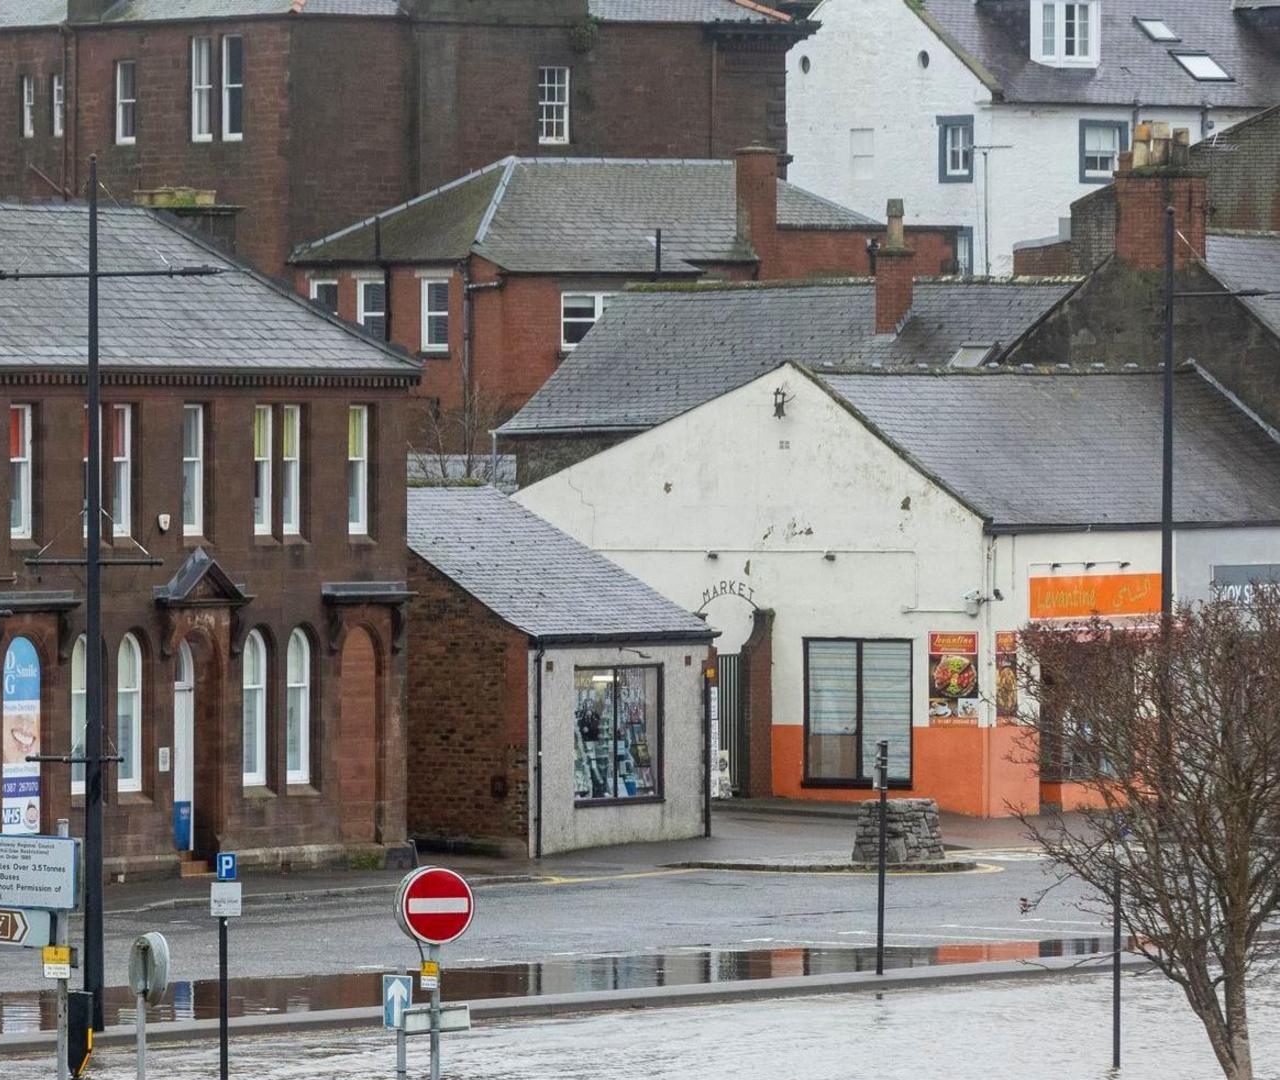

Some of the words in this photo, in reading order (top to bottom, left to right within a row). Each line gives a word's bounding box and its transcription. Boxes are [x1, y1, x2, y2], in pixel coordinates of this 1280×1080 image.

[702, 580, 755, 603] MARKET
[1037, 583, 1096, 609] Levantine
[16, 664, 37, 678] Smile
[2, 808, 20, 824] NHS
[13, 863, 29, 871] Over
[221, 856, 233, 877] P
[0, 873, 20, 881] Buses
[16, 884, 52, 892] Permission
